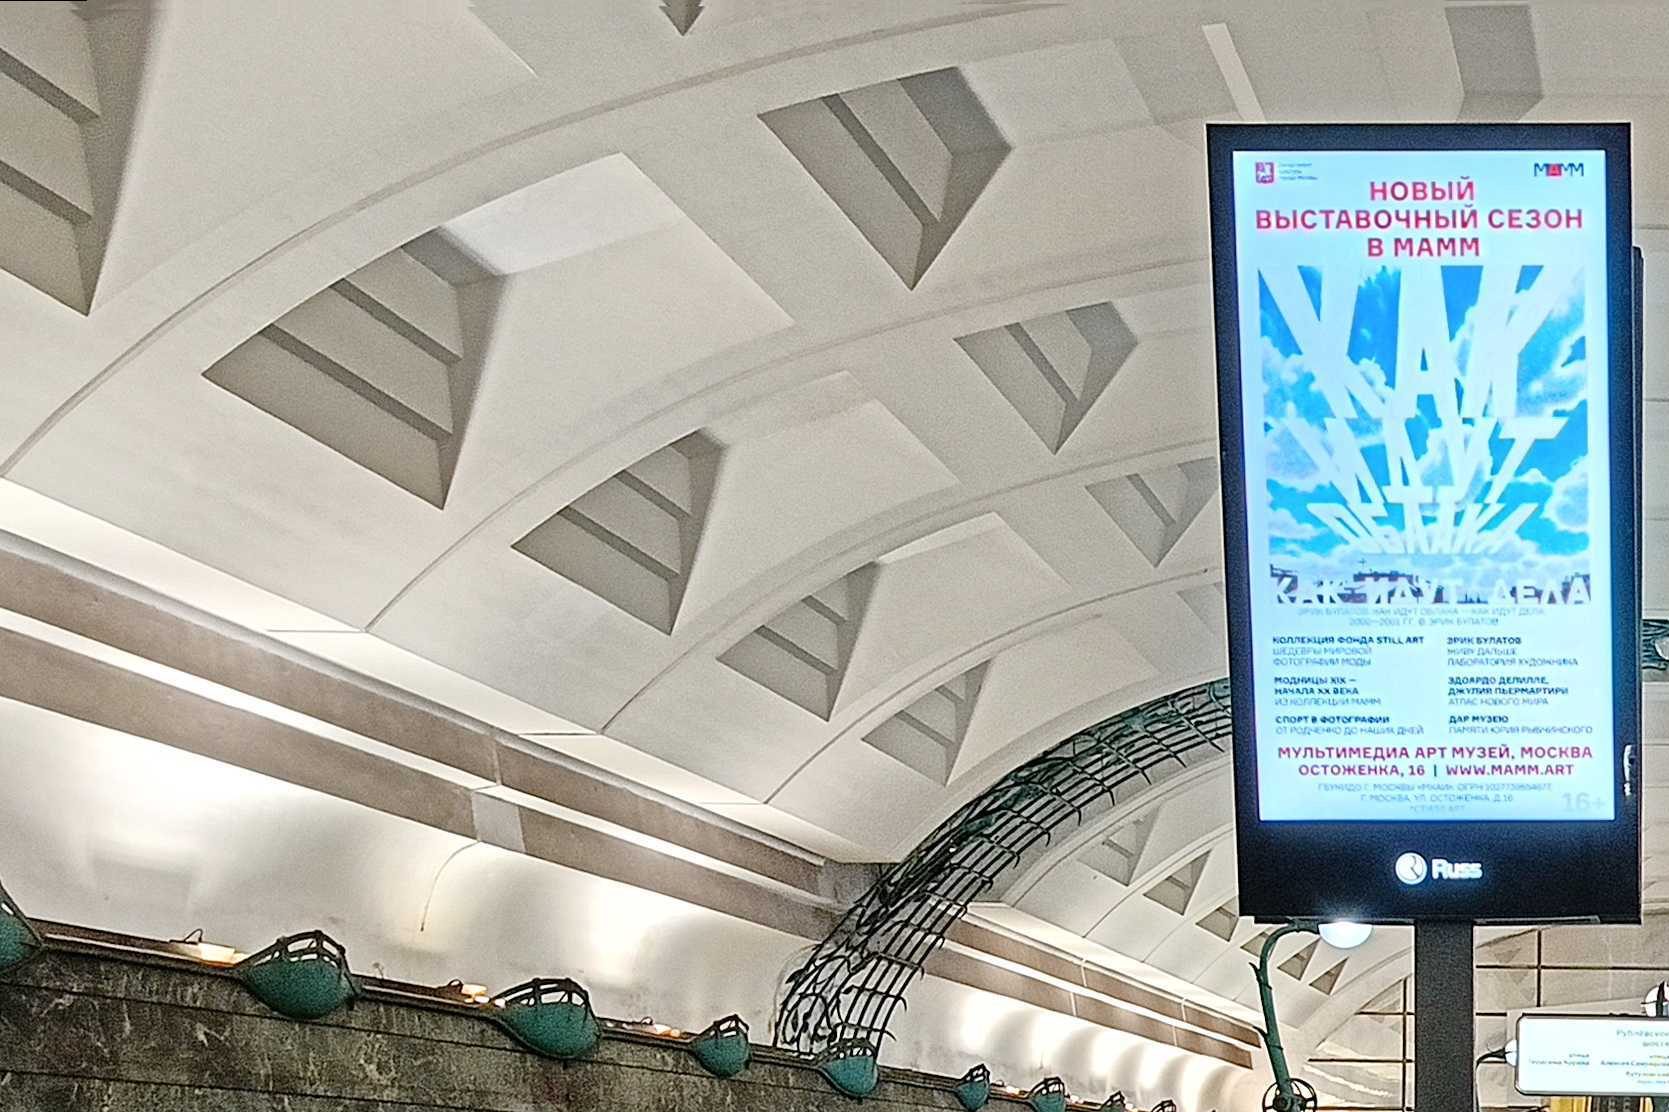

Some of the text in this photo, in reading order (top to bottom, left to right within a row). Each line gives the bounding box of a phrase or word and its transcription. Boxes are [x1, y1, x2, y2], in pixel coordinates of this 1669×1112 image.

[1369, 176, 1475, 201] НОВЫЙ
[1256, 204, 1583, 230] ВЫСТАВОЧНЫЙ СЕЗОН
[1368, 238, 1480, 257] В МАММ
[1447, 637, 1522, 645] ЭРИК БУЛАТОВ
[1274, 687, 1315, 695] НАЧАЛА
[1333, 687, 1360, 695] ВЕКА
[1275, 716, 1309, 724] СПОРТ
[1449, 715, 1509, 724] ДАР МУЗЕЮ
[1278, 743, 1593, 761] МУЛЬТИМЕДИА АРТ МУЗЕЙ, МОСКВА
[1298, 764, 1405, 778] ОСТОЖЕНКА,
[1408, 764, 1426, 776] 16
[1445, 764, 1574, 776] WWW.MAMM.ART
[1560, 792, 1606, 812] 16+
[1430, 858, 1483, 880] Russ
